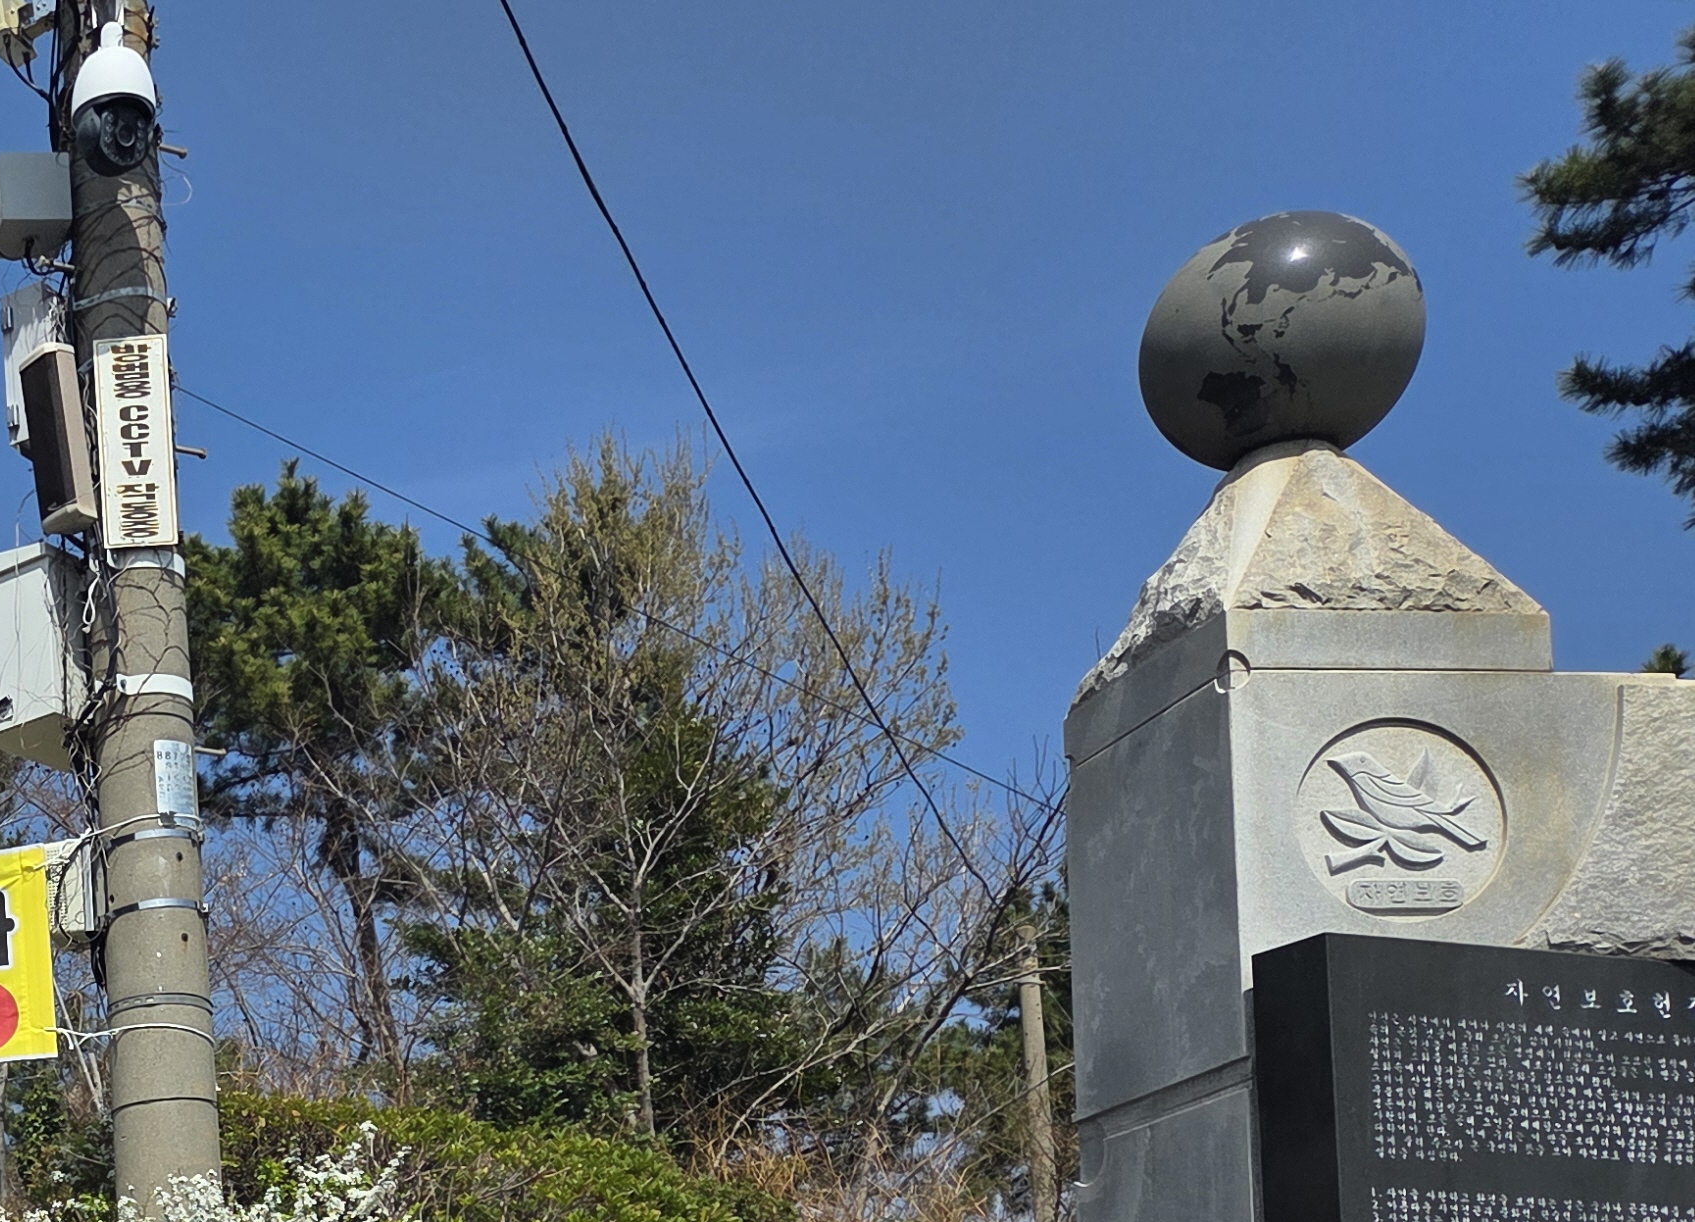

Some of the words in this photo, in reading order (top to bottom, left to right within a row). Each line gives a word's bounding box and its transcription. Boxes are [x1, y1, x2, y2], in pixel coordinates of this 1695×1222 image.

[110, 343, 152, 399] 방범용
[119, 404, 152, 476] CCTV
[116, 482, 160, 538] 작동중
